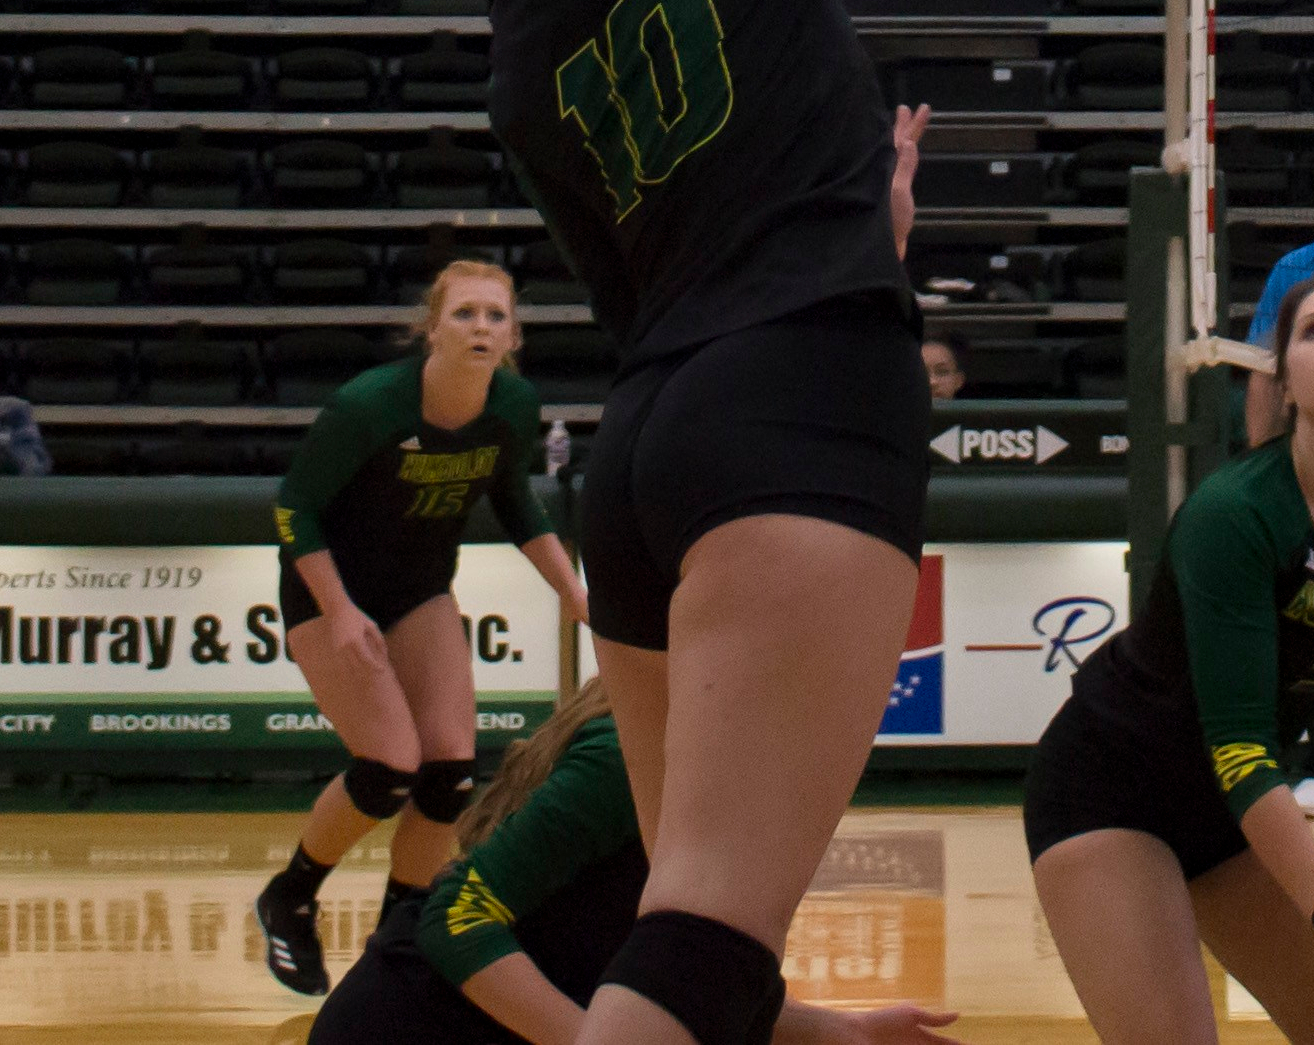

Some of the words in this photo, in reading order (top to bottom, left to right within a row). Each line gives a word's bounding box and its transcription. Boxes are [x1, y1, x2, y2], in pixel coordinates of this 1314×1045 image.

[962, 429, 1034, 458] POSS
[64, 566, 132, 589] Since
[141, 566, 203, 589] 1919
[190, 614, 230, 664] &
[90, 714, 232, 733] BROOKINGS
[265, 714, 336, 731] GRAN
[475, 713, 526, 730] END
